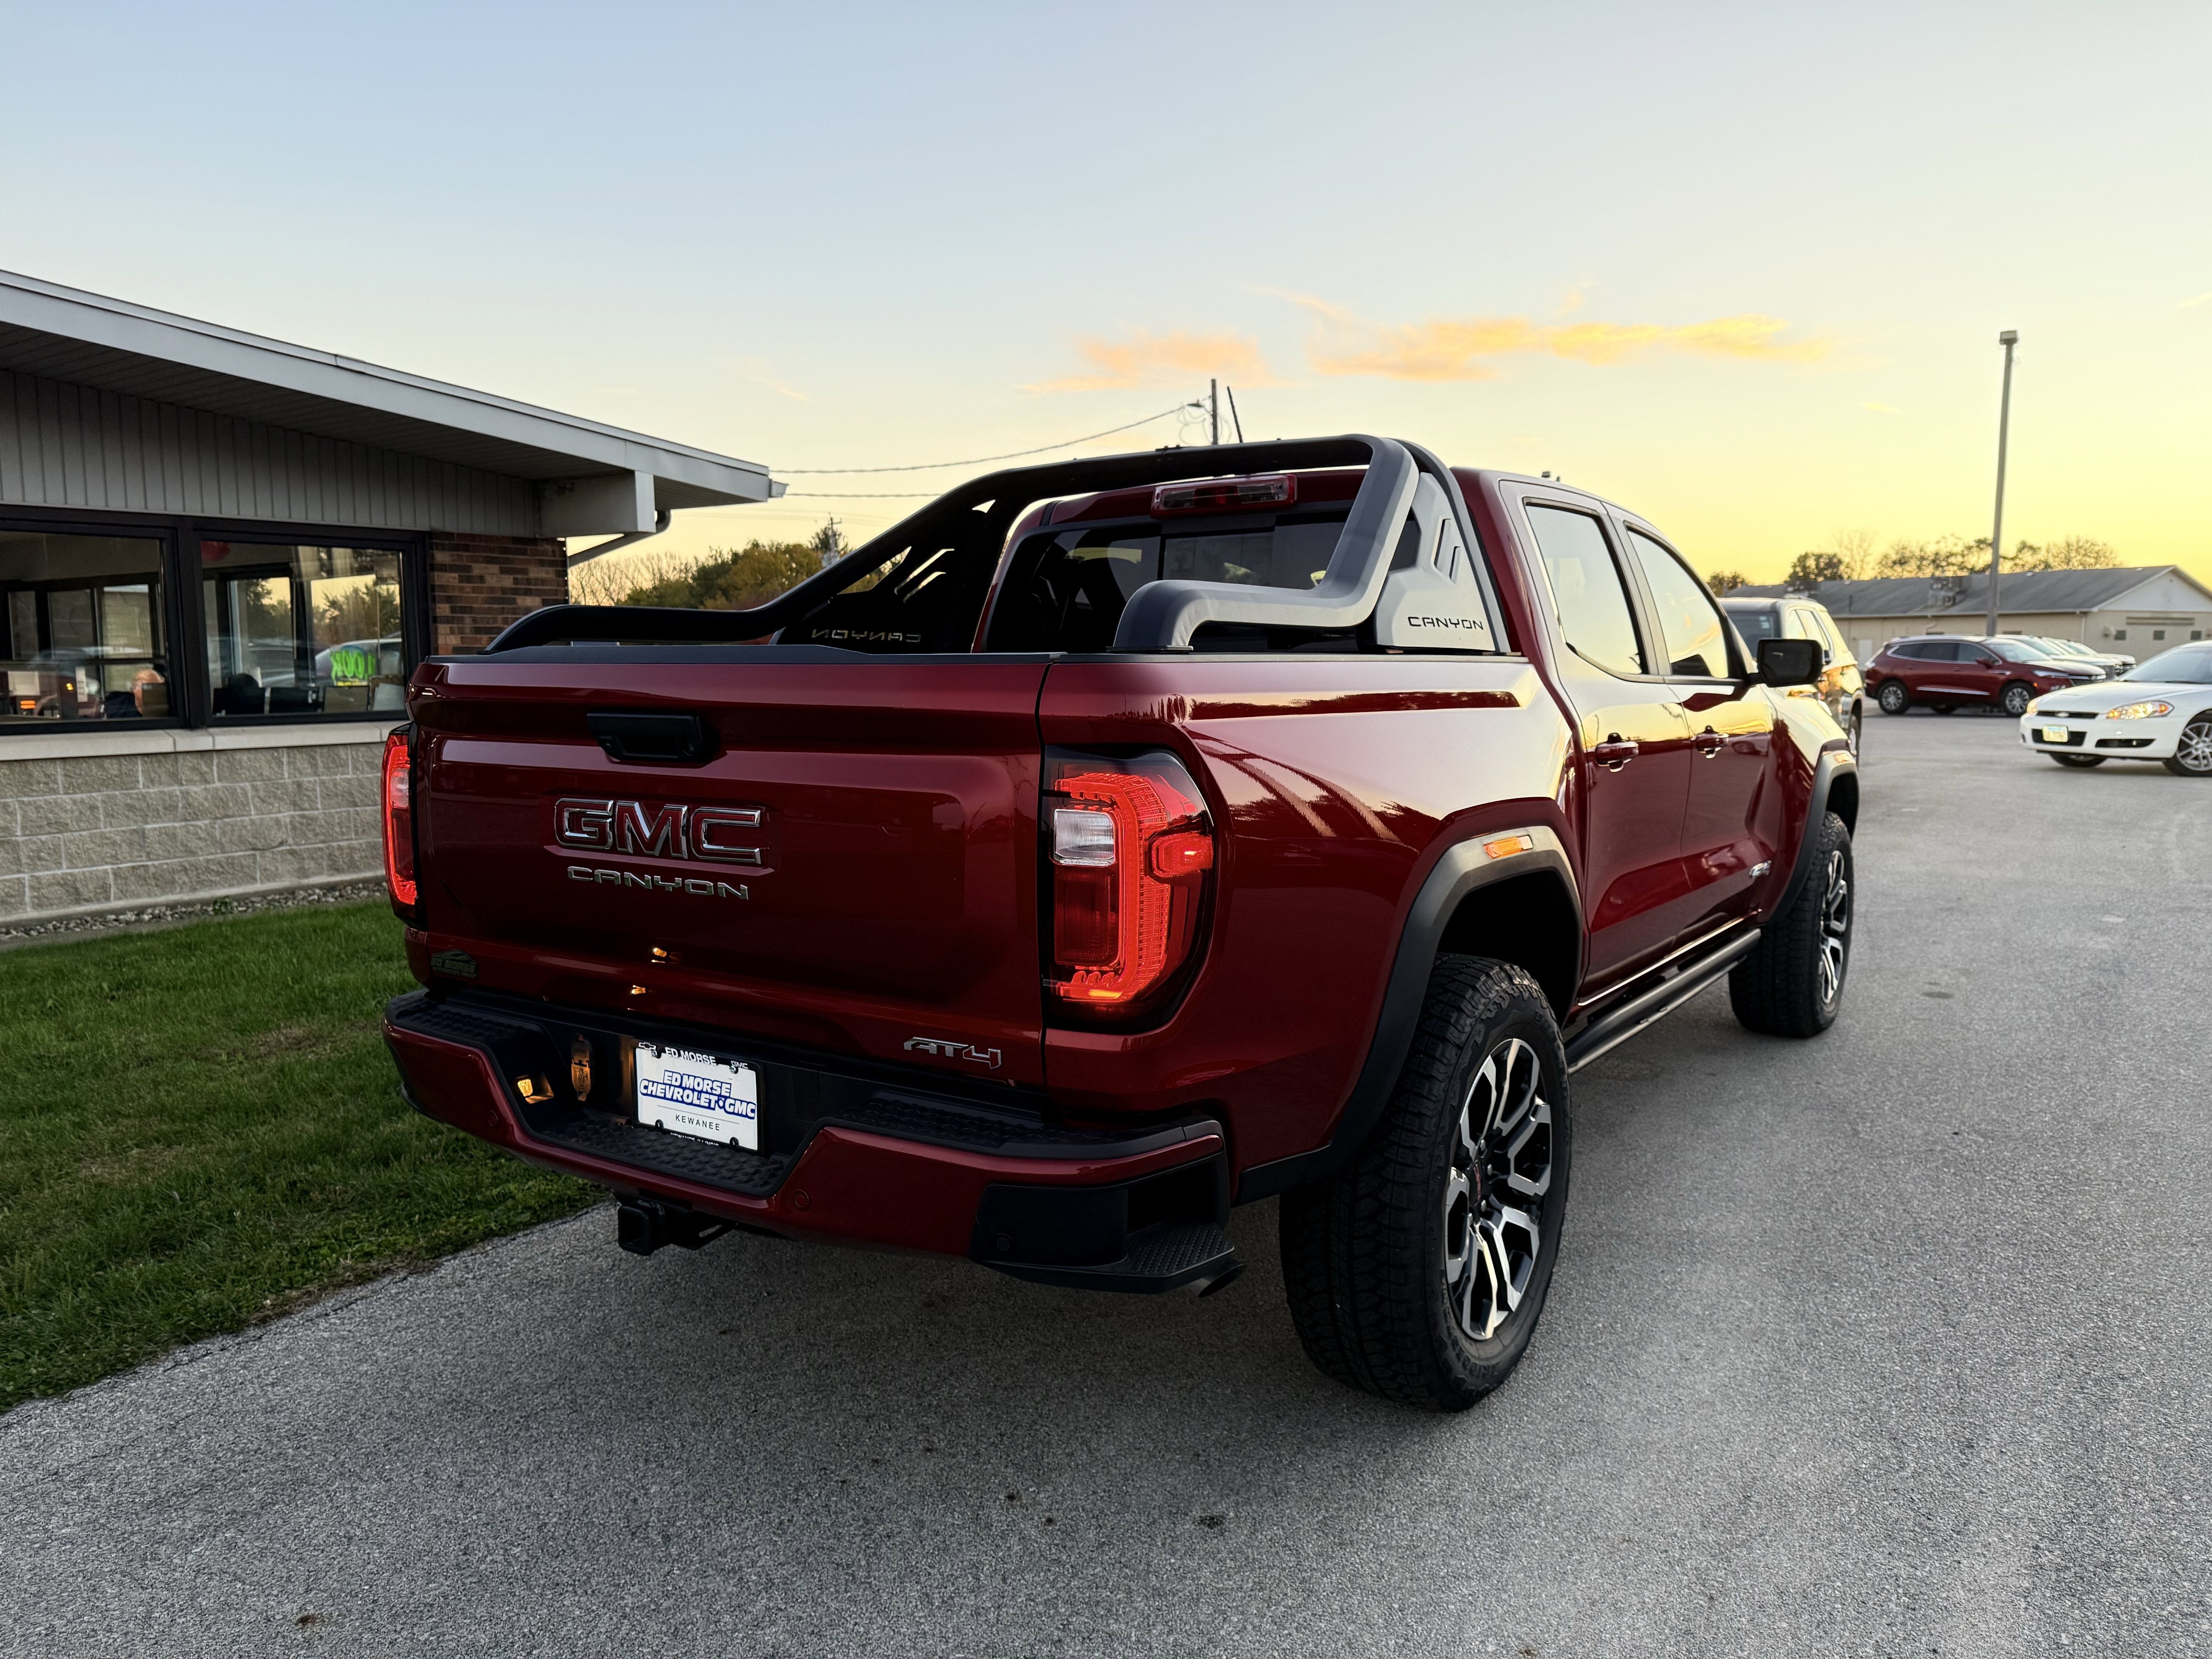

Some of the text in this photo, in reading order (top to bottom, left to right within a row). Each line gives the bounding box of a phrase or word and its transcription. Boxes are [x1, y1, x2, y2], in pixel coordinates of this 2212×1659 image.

[1408, 617, 1484, 630] CANYON
[555, 798, 761, 864] GMC
[568, 866, 749, 900] CANYON
[665, 1047, 716, 1065] ED MORSE
[904, 1037, 1002, 1069] AT4
[731, 1061, 748, 1069] GMC
[663, 1070, 732, 1097] ED MORSE
[676, 1114, 720, 1131] KEWANEE
